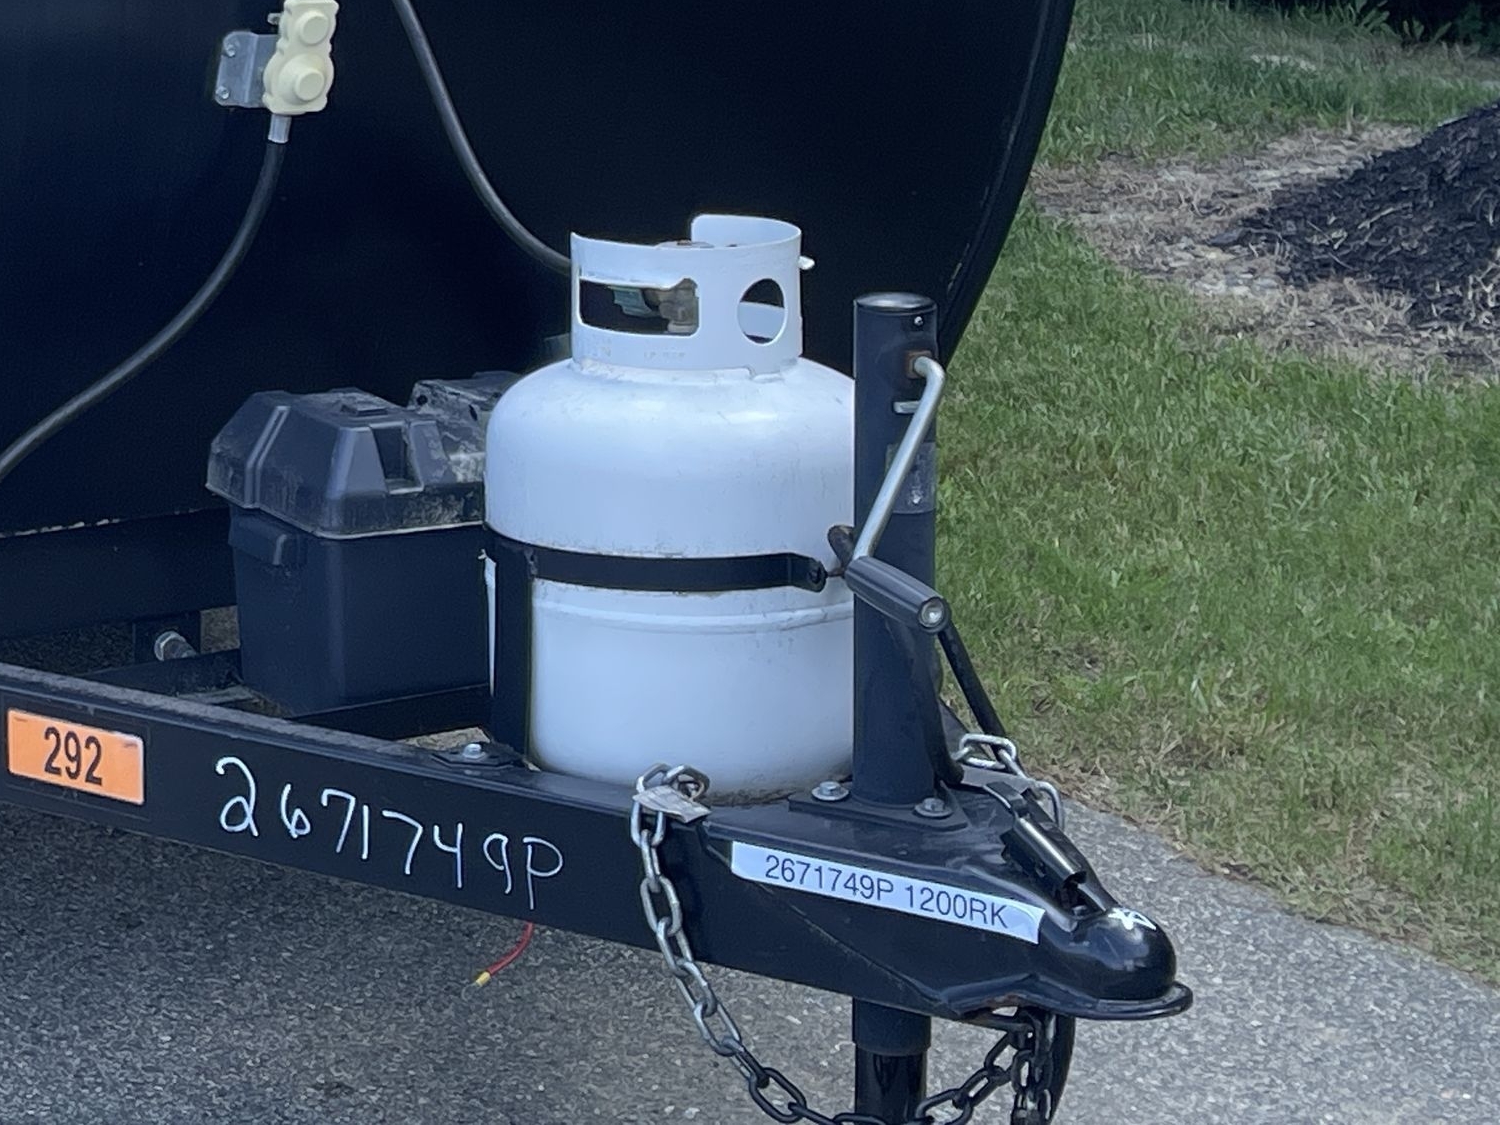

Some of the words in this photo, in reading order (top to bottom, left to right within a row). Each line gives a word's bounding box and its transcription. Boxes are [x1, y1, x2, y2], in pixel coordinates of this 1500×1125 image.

[43, 726, 103, 786] 292
[765, 854, 894, 901] 2671749P
[905, 884, 1009, 929] 1200RK
